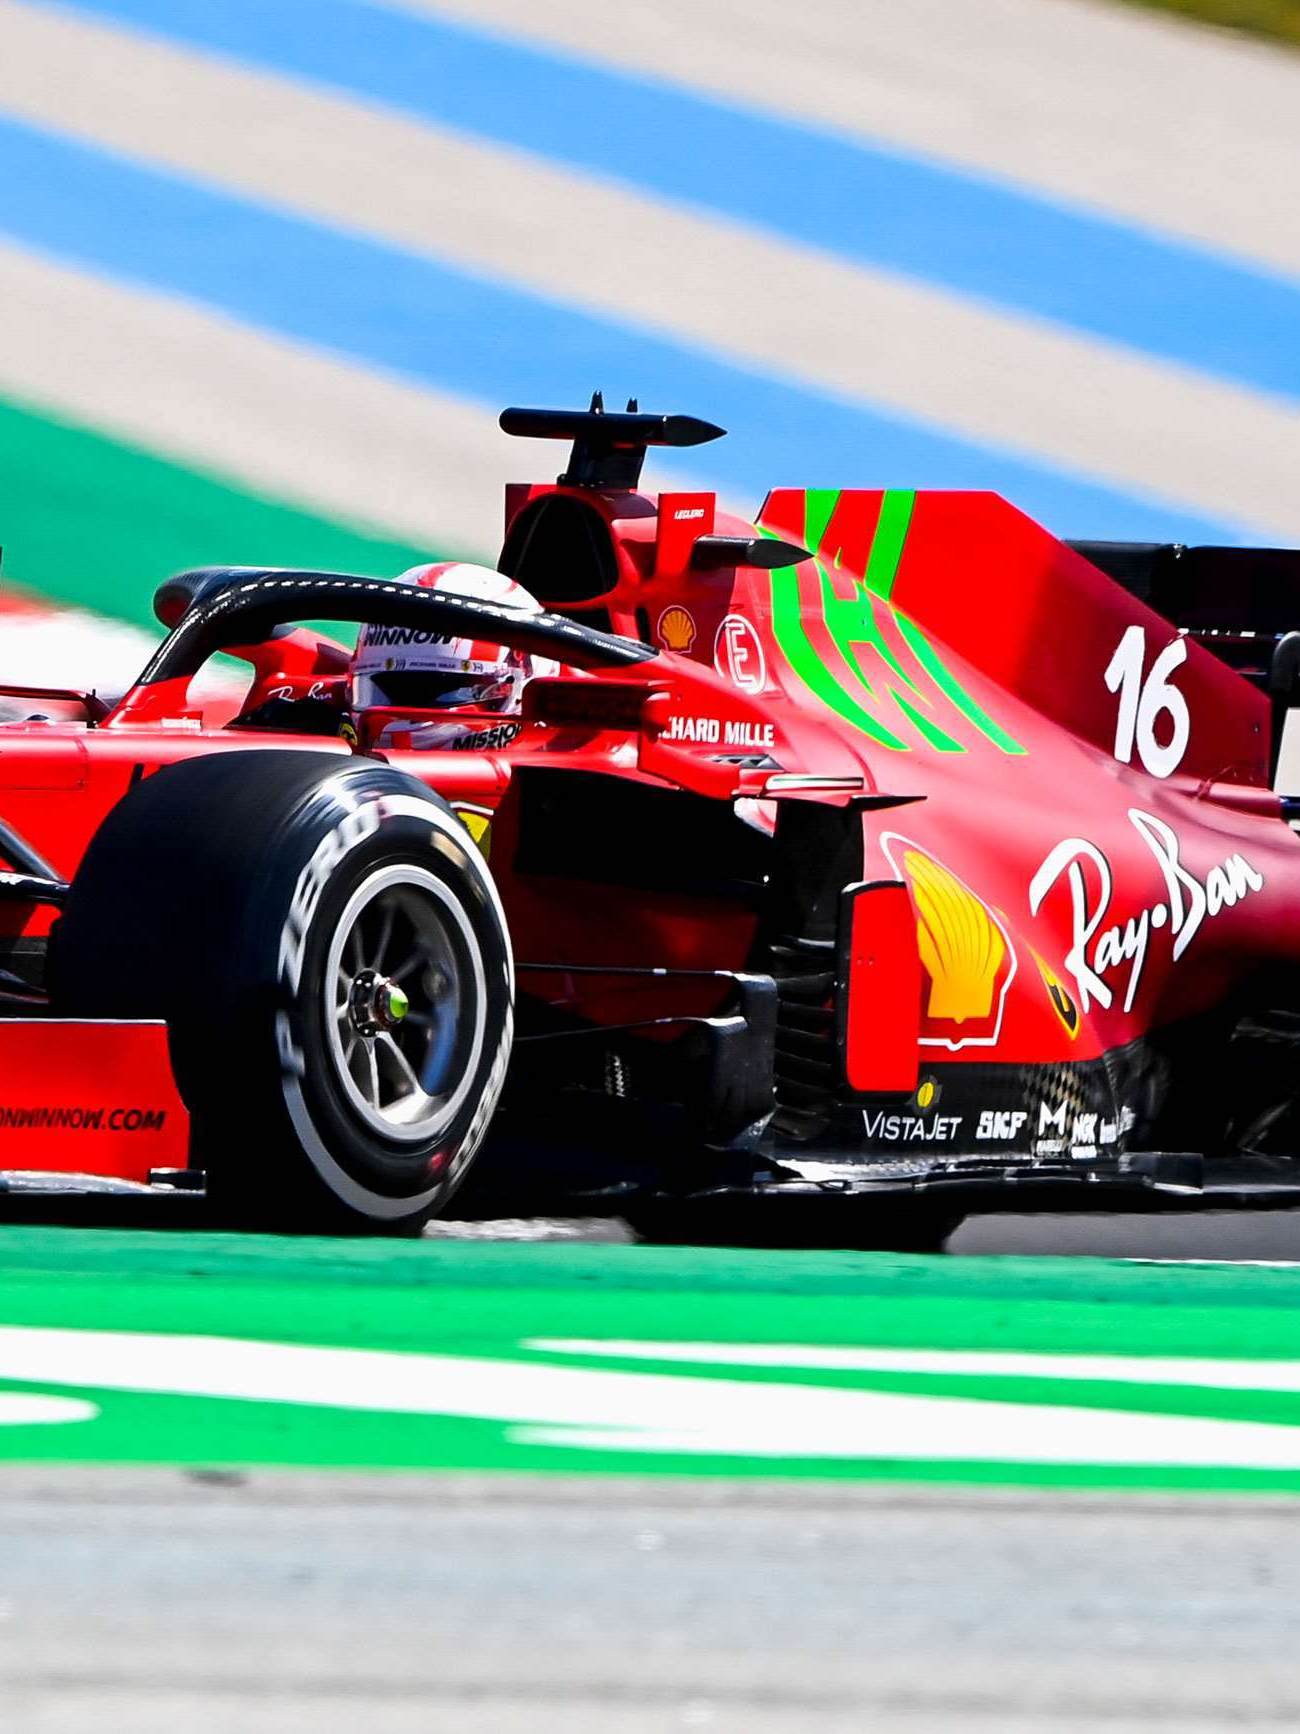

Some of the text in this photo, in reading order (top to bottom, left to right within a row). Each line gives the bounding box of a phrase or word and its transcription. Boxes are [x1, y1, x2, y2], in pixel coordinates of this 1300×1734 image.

[1104, 625, 1190, 779] 16
[724, 720, 775, 747] MILLE
[975, 1111, 1027, 1139] SKF
